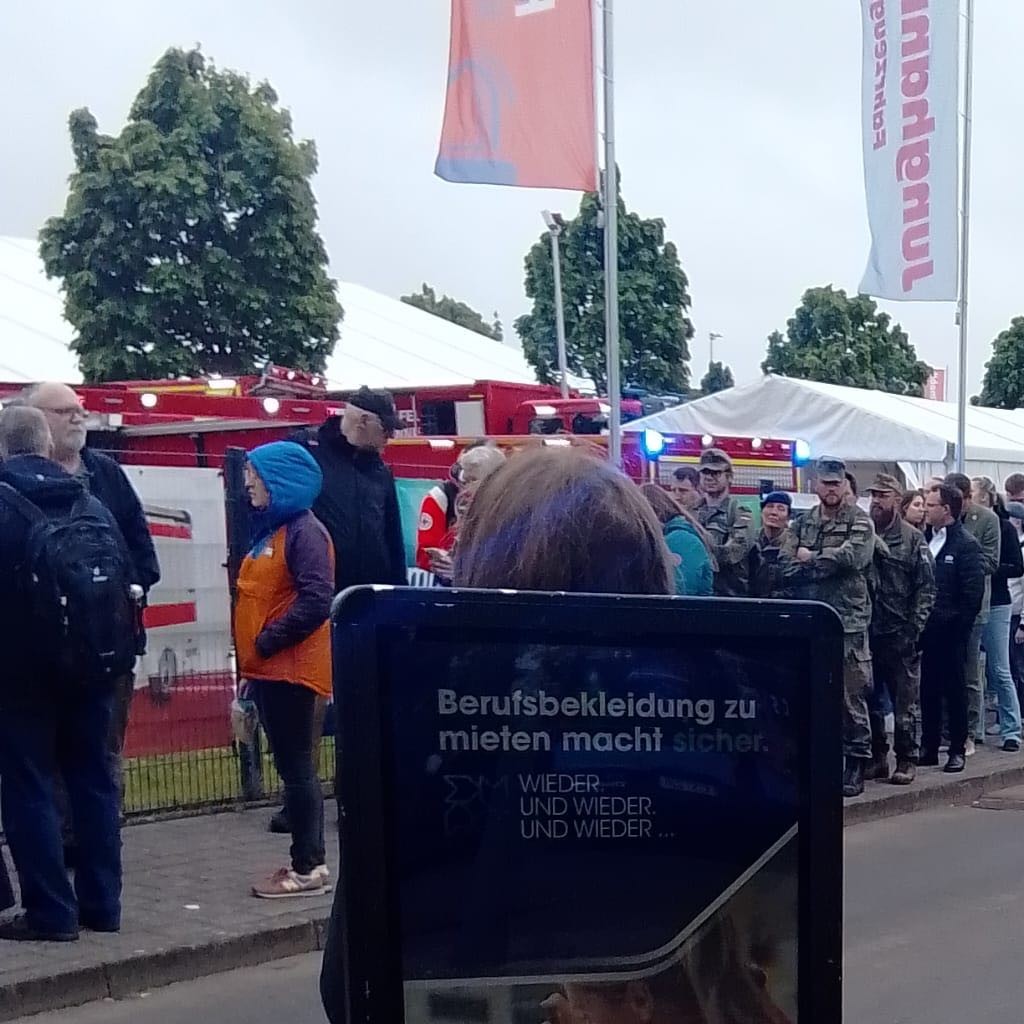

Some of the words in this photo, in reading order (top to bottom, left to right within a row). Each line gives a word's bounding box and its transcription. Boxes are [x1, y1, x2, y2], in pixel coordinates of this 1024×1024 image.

[437, 688, 716, 726] Berufsbekleidung
[724, 698, 757, 720] zu
[438, 724, 552, 752] mieten
[562, 727, 664, 753] macht
[673, 728, 769, 753] sicher.
[520, 796, 568, 817] UND
[573, 796, 657, 817] WIEDER.
[520, 818, 568, 839] UND
